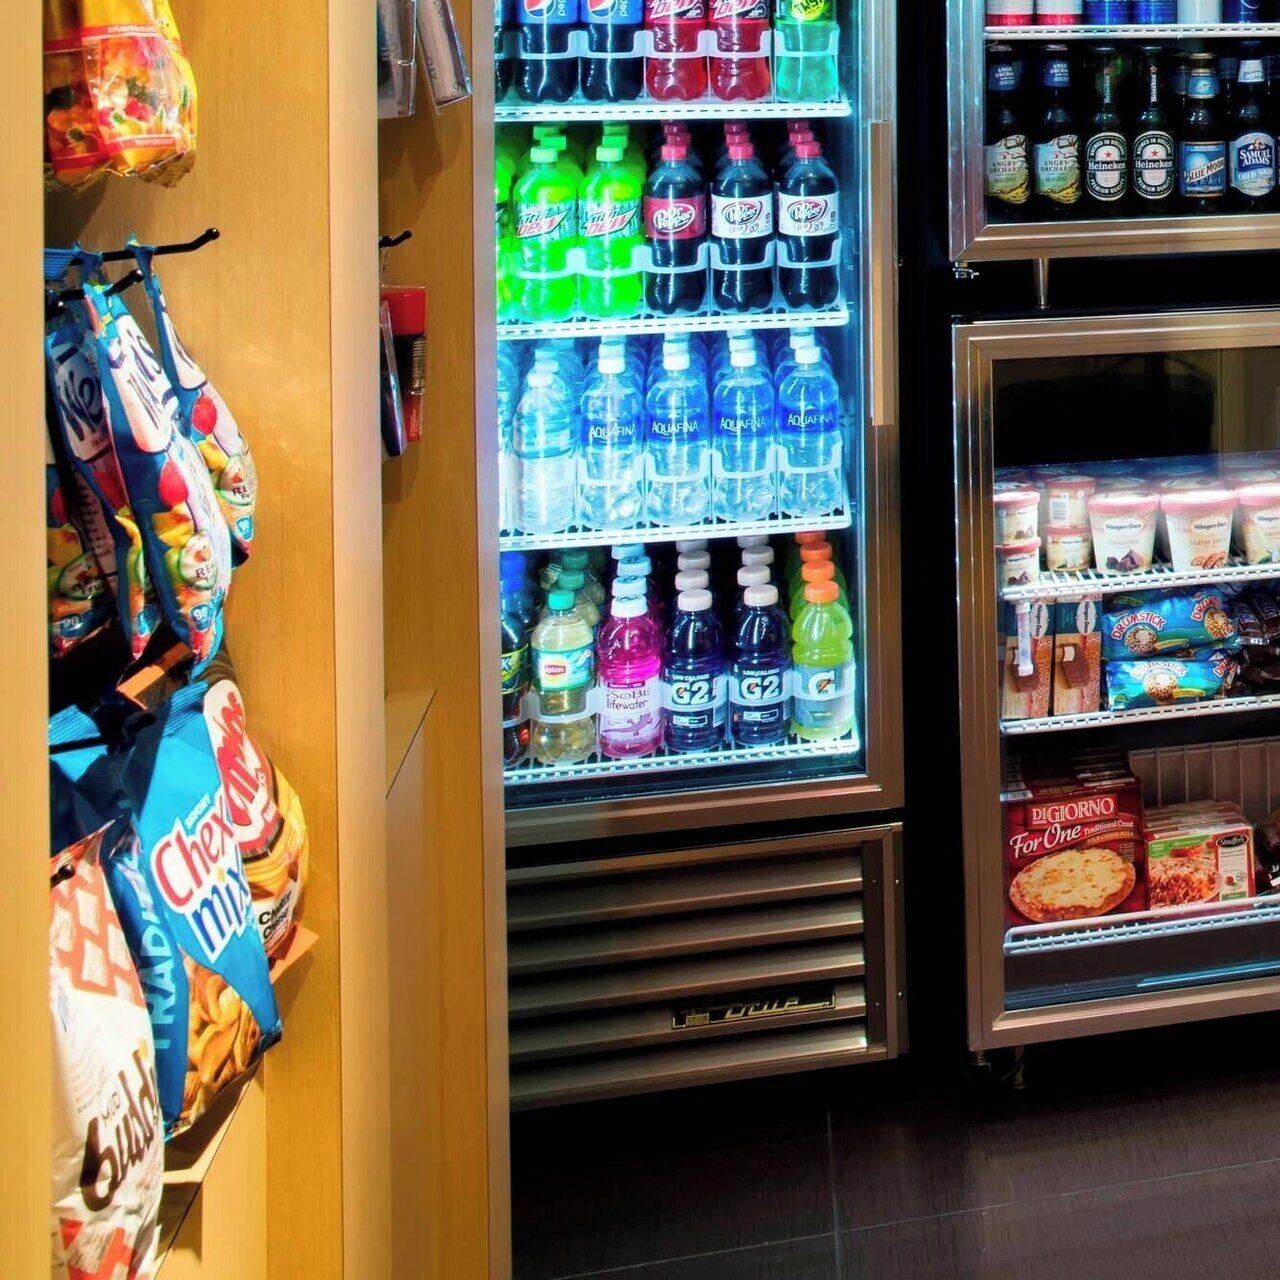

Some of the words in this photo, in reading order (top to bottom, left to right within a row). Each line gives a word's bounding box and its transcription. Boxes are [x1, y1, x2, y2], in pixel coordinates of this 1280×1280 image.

[1239, 148, 1272, 160] SAMUEL
[1242, 156, 1271, 167] ADAMS
[1088, 160, 1126, 170] Heineken
[1135, 160, 1173, 169] Heineken
[720, 416, 766, 430] AQUAFINA
[787, 411, 834, 427] AQUAFINA
[589, 424, 636, 439] AQUAFINA
[652, 420, 698, 436] AQUAFINA
[1112, 611, 1166, 640] DRUMSTICK
[1130, 662, 1190, 678] DRUMSTICK
[741, 675, 780, 701] G2
[808, 670, 836, 697] G
[671, 680, 711, 706] G2
[607, 699, 648, 711] lifewater
[1084, 820, 1118, 836] Traditional
[1009, 831, 1043, 858] For
[1043, 823, 1082, 849] One
[155, 810, 233, 908] Chex
